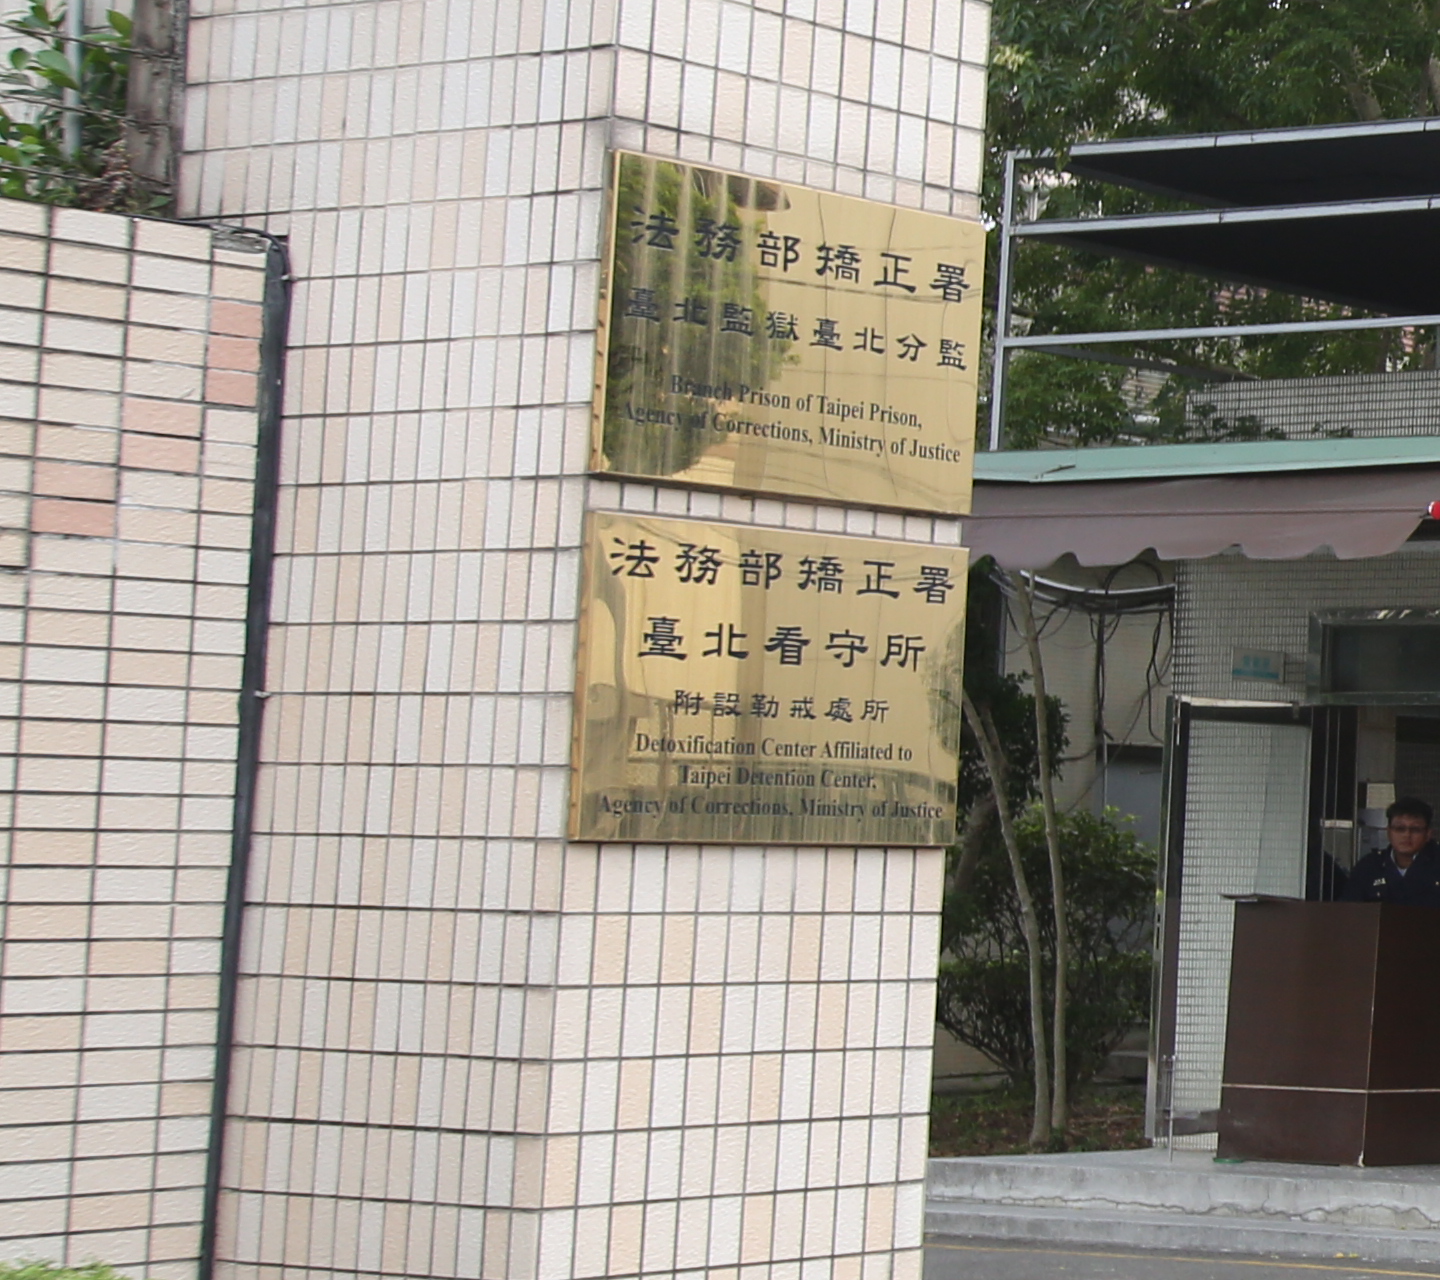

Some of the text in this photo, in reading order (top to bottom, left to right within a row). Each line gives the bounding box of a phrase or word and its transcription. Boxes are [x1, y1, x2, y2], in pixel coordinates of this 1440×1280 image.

[631, 207, 970, 303] 法務部矯正署
[624, 286, 967, 371] 臺北監獄臺北分監
[672, 375, 922, 430] Branch Prison of Taipei Prison,
[623, 404, 961, 463] Agency of Corrections, Ministry of Justice
[610, 537, 955, 605] 法務部矯正署
[638, 617, 927, 672] 臺北看守所
[673, 690, 890, 724] 附設勒戒處所
[636, 733, 912, 761] Detoxification Center Affiliated to
[679, 765, 877, 791] Taipei Detention Center,
[599, 796, 943, 821] Agency of Corrections, Ministry of Justice
